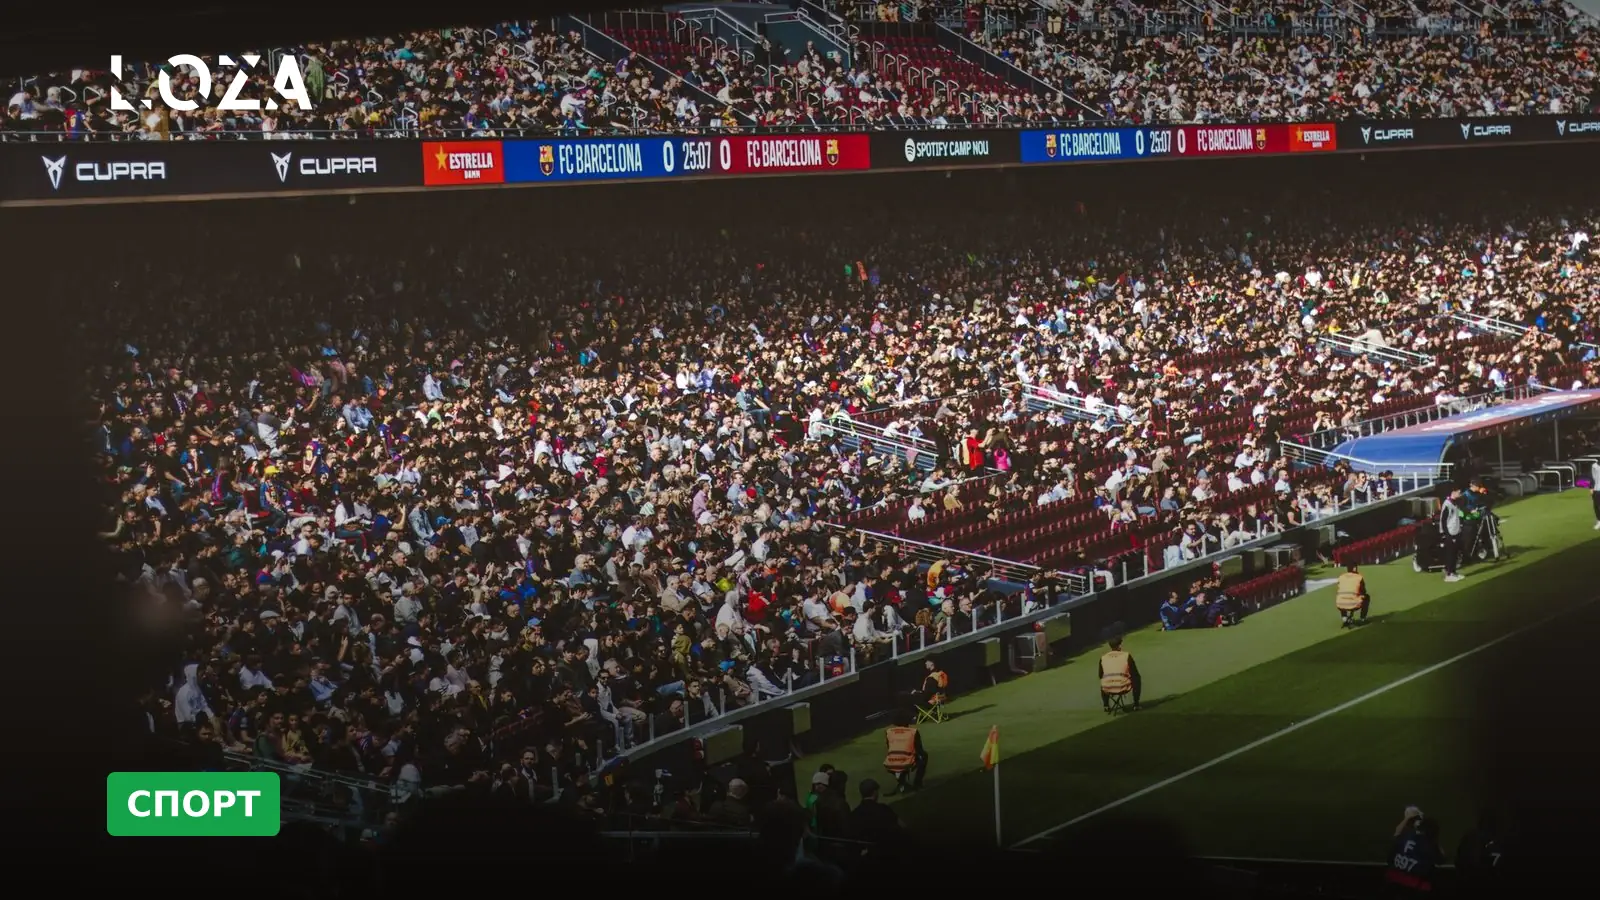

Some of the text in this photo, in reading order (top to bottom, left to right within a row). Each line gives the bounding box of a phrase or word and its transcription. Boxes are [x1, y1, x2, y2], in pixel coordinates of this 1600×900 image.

[1150, 130, 1172, 153] 25:07
[1177, 129, 1186, 153] 0
[1197, 128, 1253, 151] FC BARCELONA
[1374, 128, 1414, 140] CUPRA
[1473, 125, 1512, 136] CUPRA
[746, 139, 822, 168] FC BARCELONA
[916, 140, 989, 157] SPOTIFY CAMP NOU
[1060, 132, 1121, 157] FC BARCELONA
[1135, 130, 1144, 155] 0
[300, 157, 377, 175] CUPRA
[449, 152, 494, 170] ESTRELLA
[558, 143, 643, 174] FC BARCELONA
[662, 140, 675, 172] 0
[682, 141, 712, 170] 25:07
[719, 139, 732, 170] 0
[75, 161, 166, 181] CUPRA
[1403, 840, 1417, 853] F
[1394, 853, 1419, 872] 697
